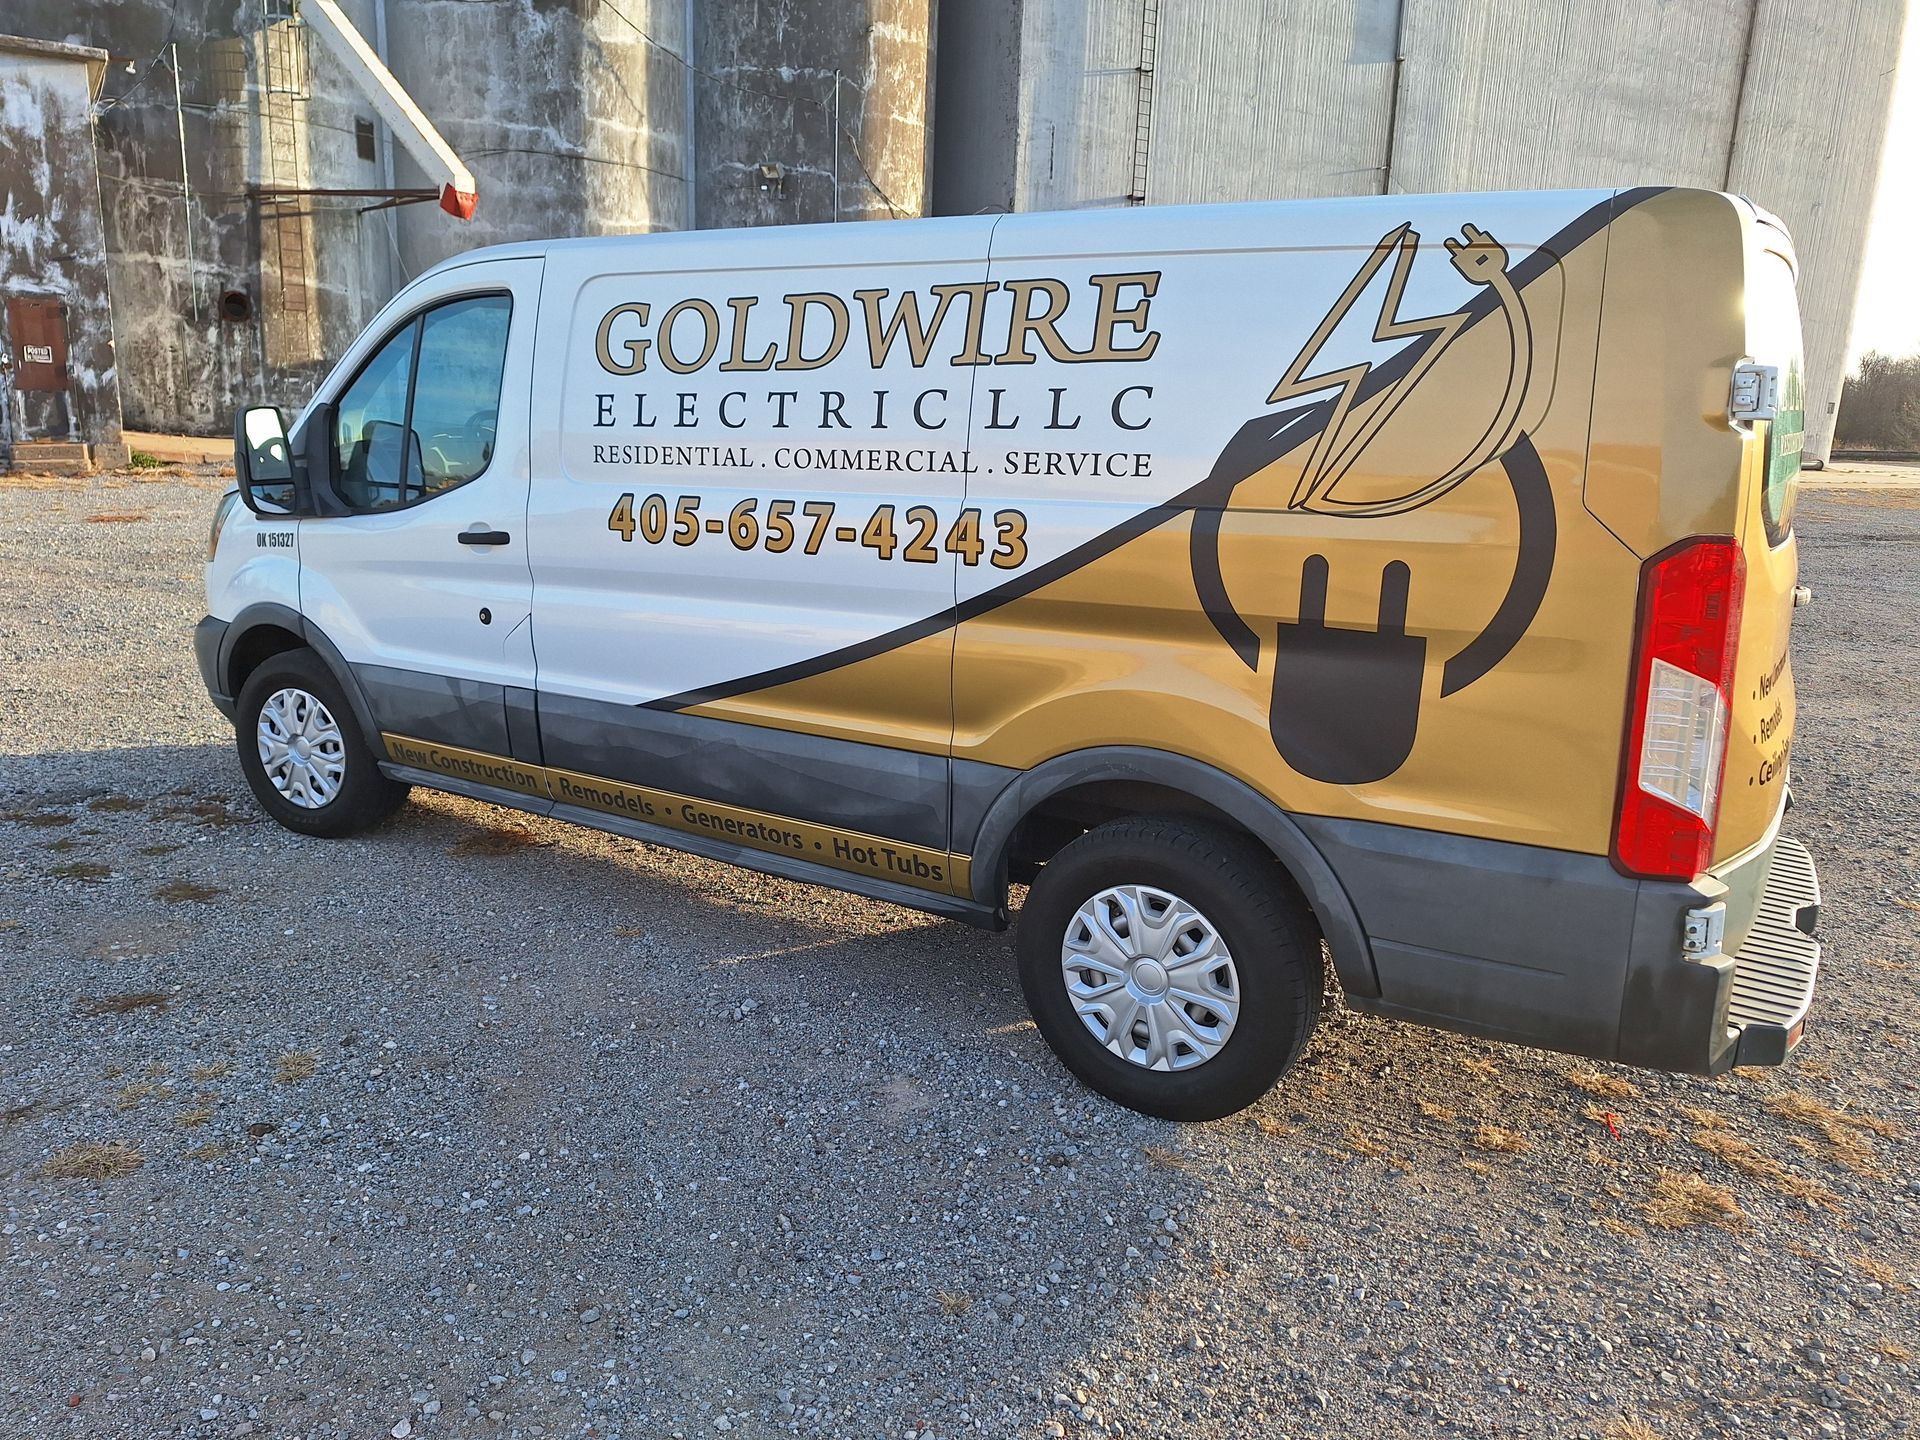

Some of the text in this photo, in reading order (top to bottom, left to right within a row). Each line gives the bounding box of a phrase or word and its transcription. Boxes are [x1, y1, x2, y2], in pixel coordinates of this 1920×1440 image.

[595, 271, 1161, 376] GOLDWIRE
[593, 386, 1153, 430] ELECTRIC LLC
[593, 445, 1153, 478] RESIDENTIAL COMMERCIAL SERVICE
[256, 532, 294, 547] OK 151327
[608, 493, 1028, 569] 405-657-4243
[393, 741, 944, 882] New Construction Remodels Generators Hot Tubs
